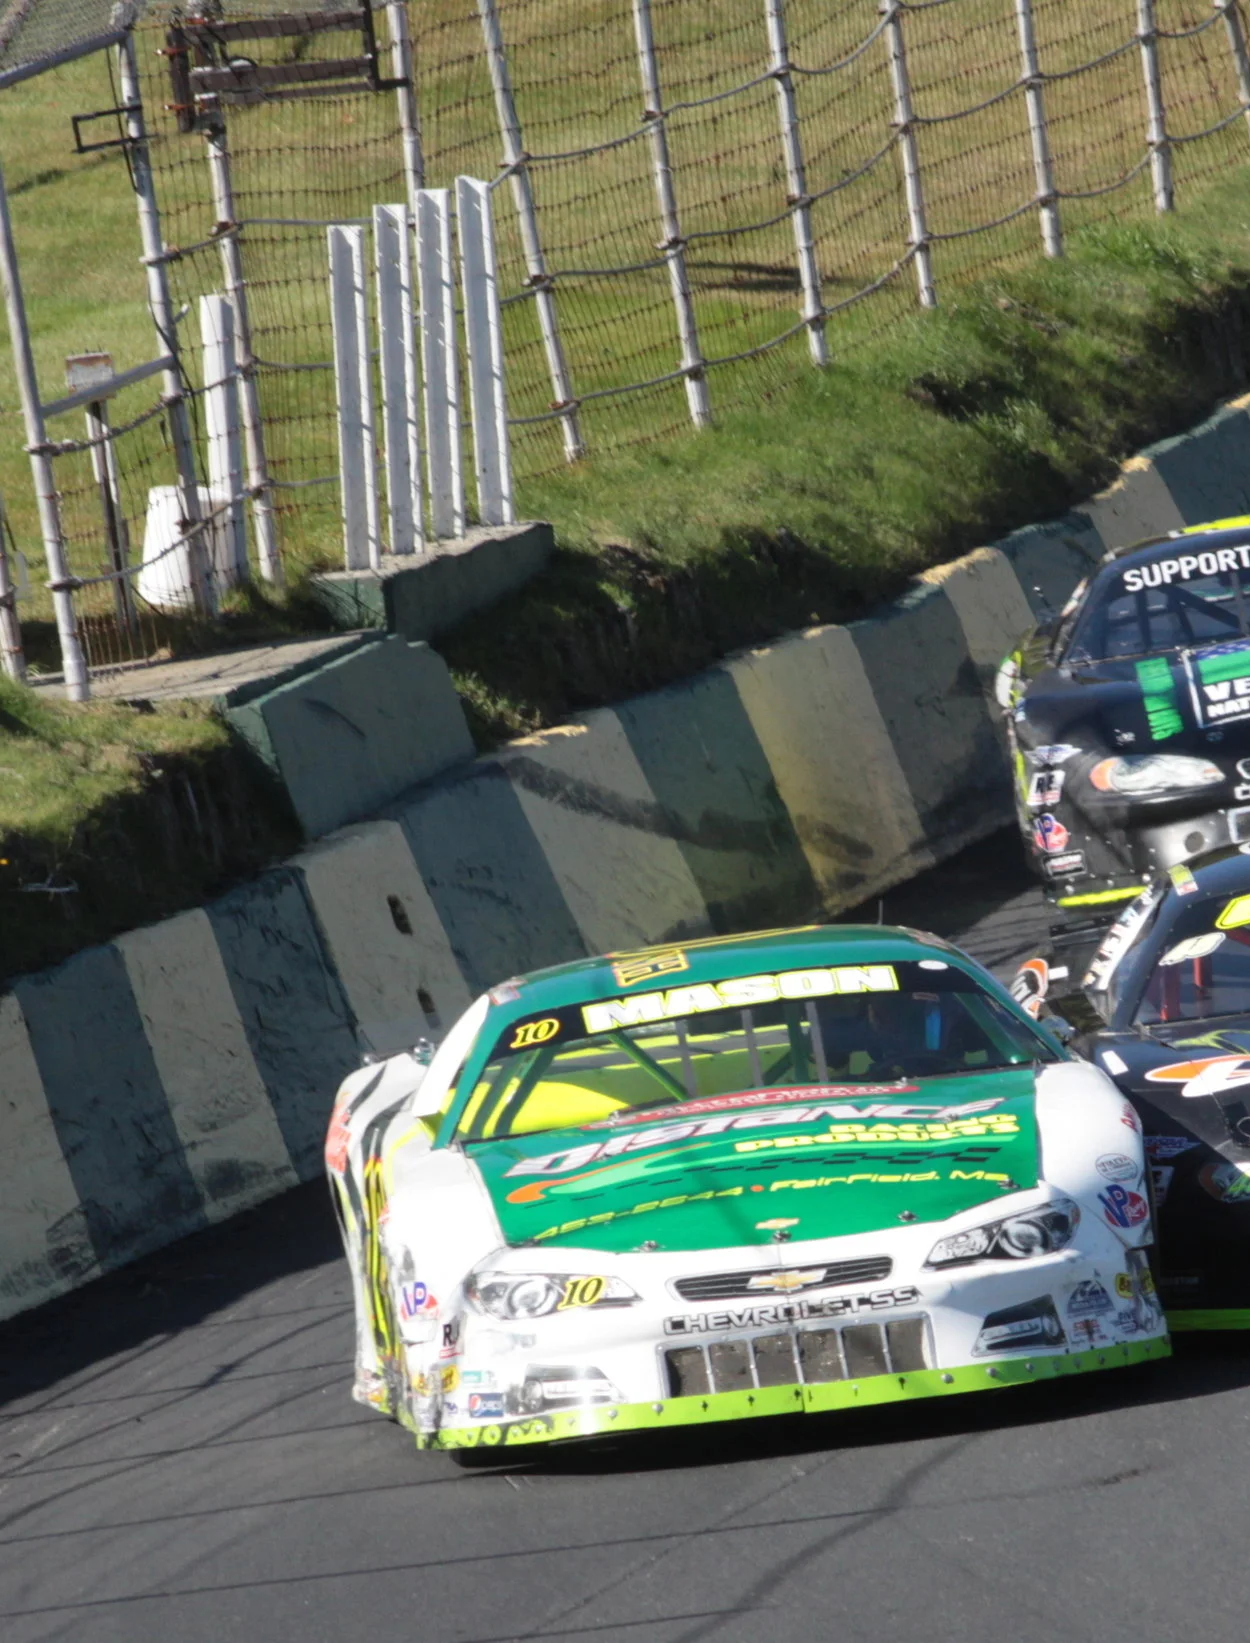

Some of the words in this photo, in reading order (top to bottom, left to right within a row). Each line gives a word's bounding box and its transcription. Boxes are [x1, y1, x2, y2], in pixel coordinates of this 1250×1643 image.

[582, 963, 900, 1034] MASON
[510, 1018, 560, 1049] 10
[734, 1121, 1021, 1152] PRODUCTS
[829, 1113, 1018, 1134] RACING
[557, 1276, 605, 1311] 10
[663, 1296, 865, 1335] CHEVROLET
[868, 1285, 922, 1311] SS
